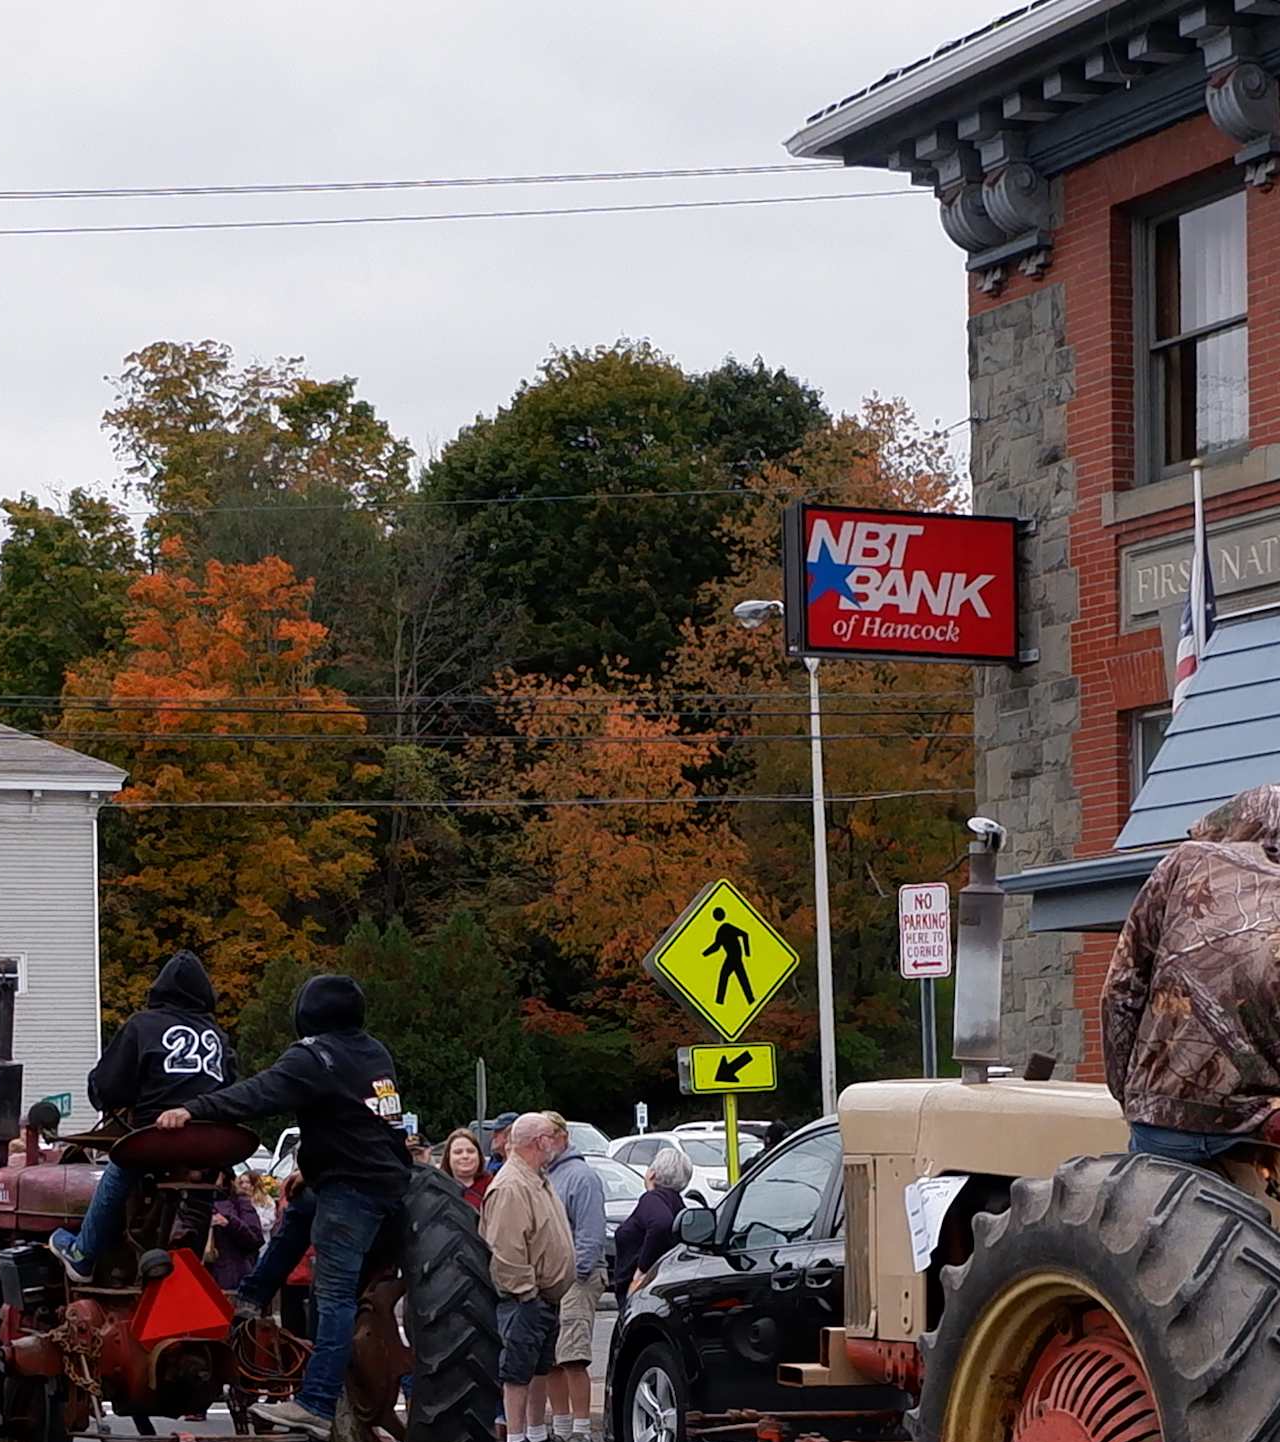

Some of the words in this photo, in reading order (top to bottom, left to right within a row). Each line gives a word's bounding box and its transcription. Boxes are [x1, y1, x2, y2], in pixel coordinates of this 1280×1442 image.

[807, 519, 924, 568] NBT
[1137, 558, 1192, 603] FIRS
[839, 567, 996, 618] BANK
[832, 616, 857, 642] of
[861, 617, 960, 642] Hancock
[914, 892, 932, 911] NO
[903, 912, 946, 931] PARKING
[905, 932, 929, 945] HERE
[932, 931, 944, 944] TO
[907, 945, 944, 958] CORNER
